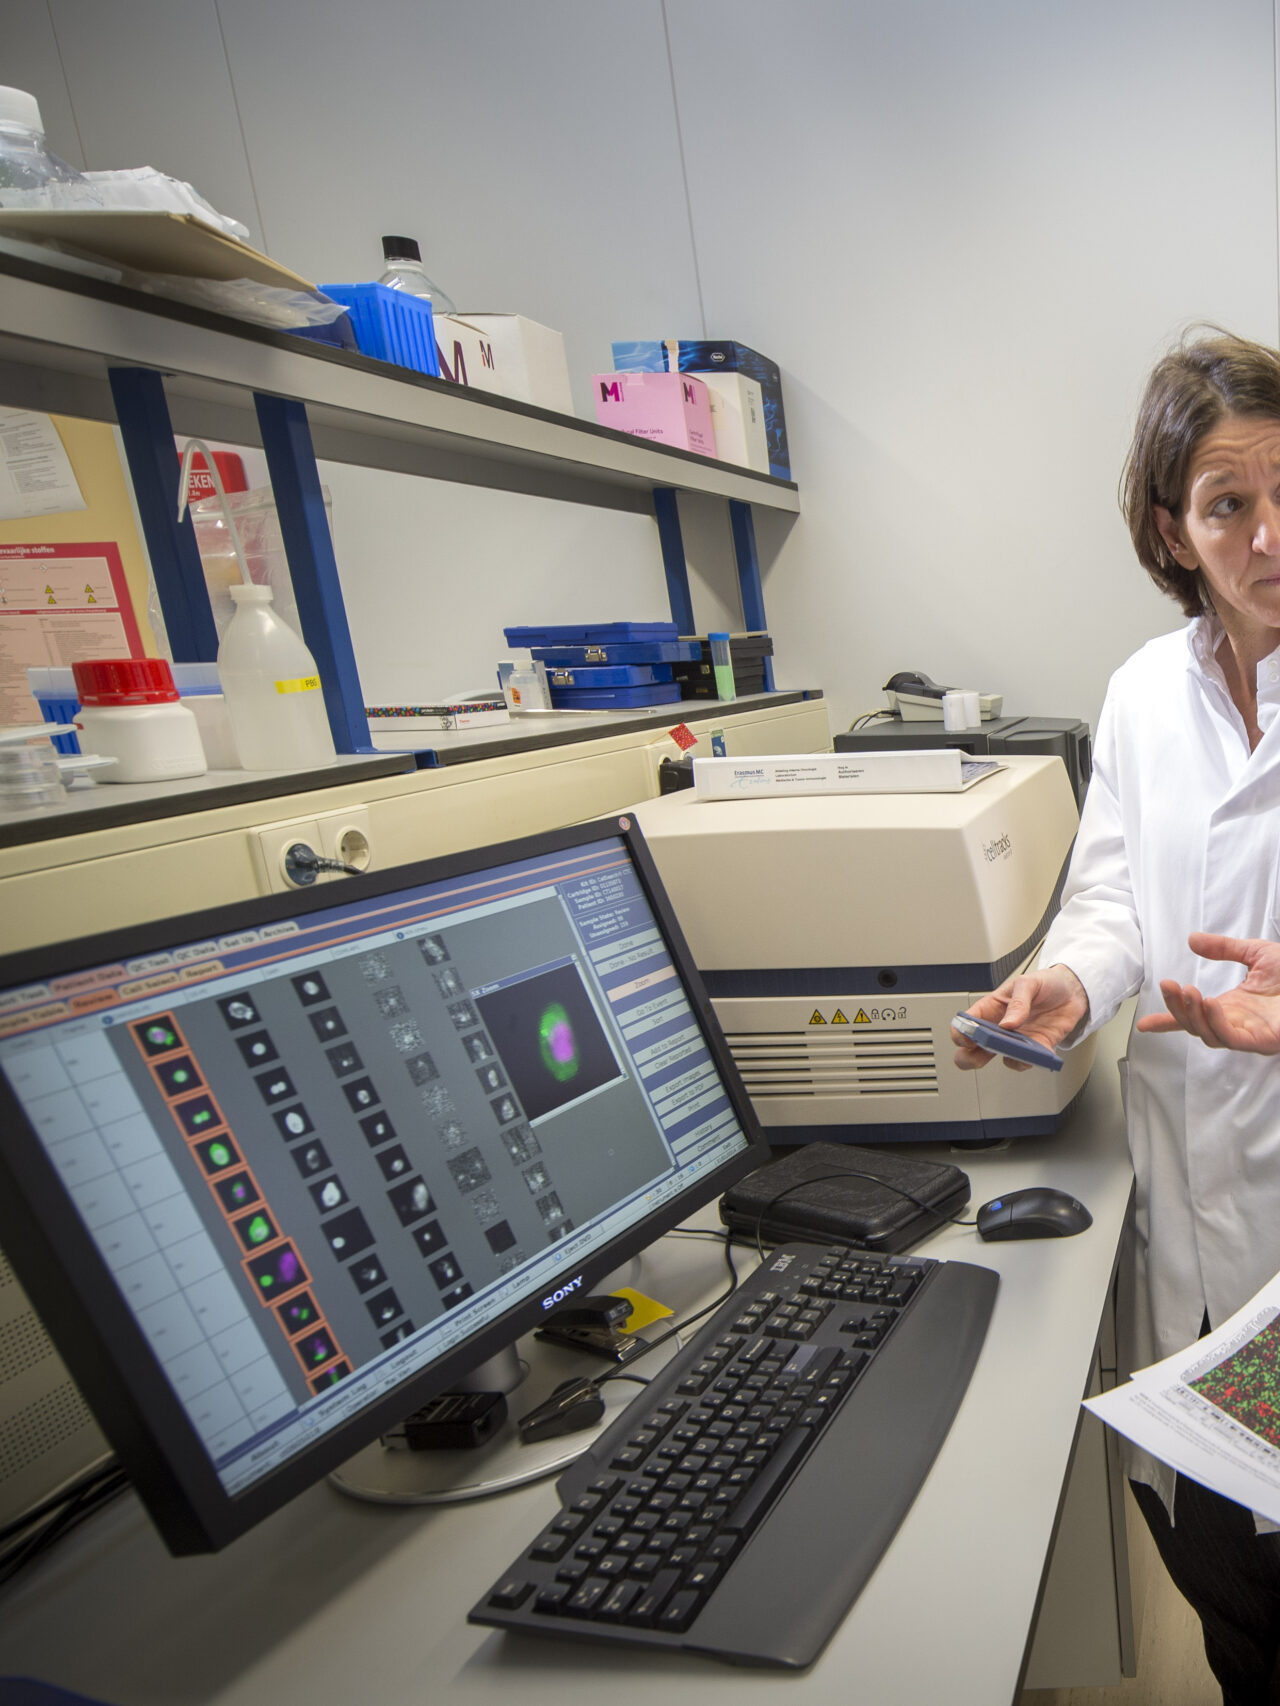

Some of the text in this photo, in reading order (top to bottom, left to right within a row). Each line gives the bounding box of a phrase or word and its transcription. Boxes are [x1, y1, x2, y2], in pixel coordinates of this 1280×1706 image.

[734, 769, 756, 777] Erasmus
[634, 978, 649, 989] Zoom
[769, 1253, 796, 1273] IBM
[541, 1275, 584, 1311] SONY
[454, 1298, 496, 1327] Print Screen
